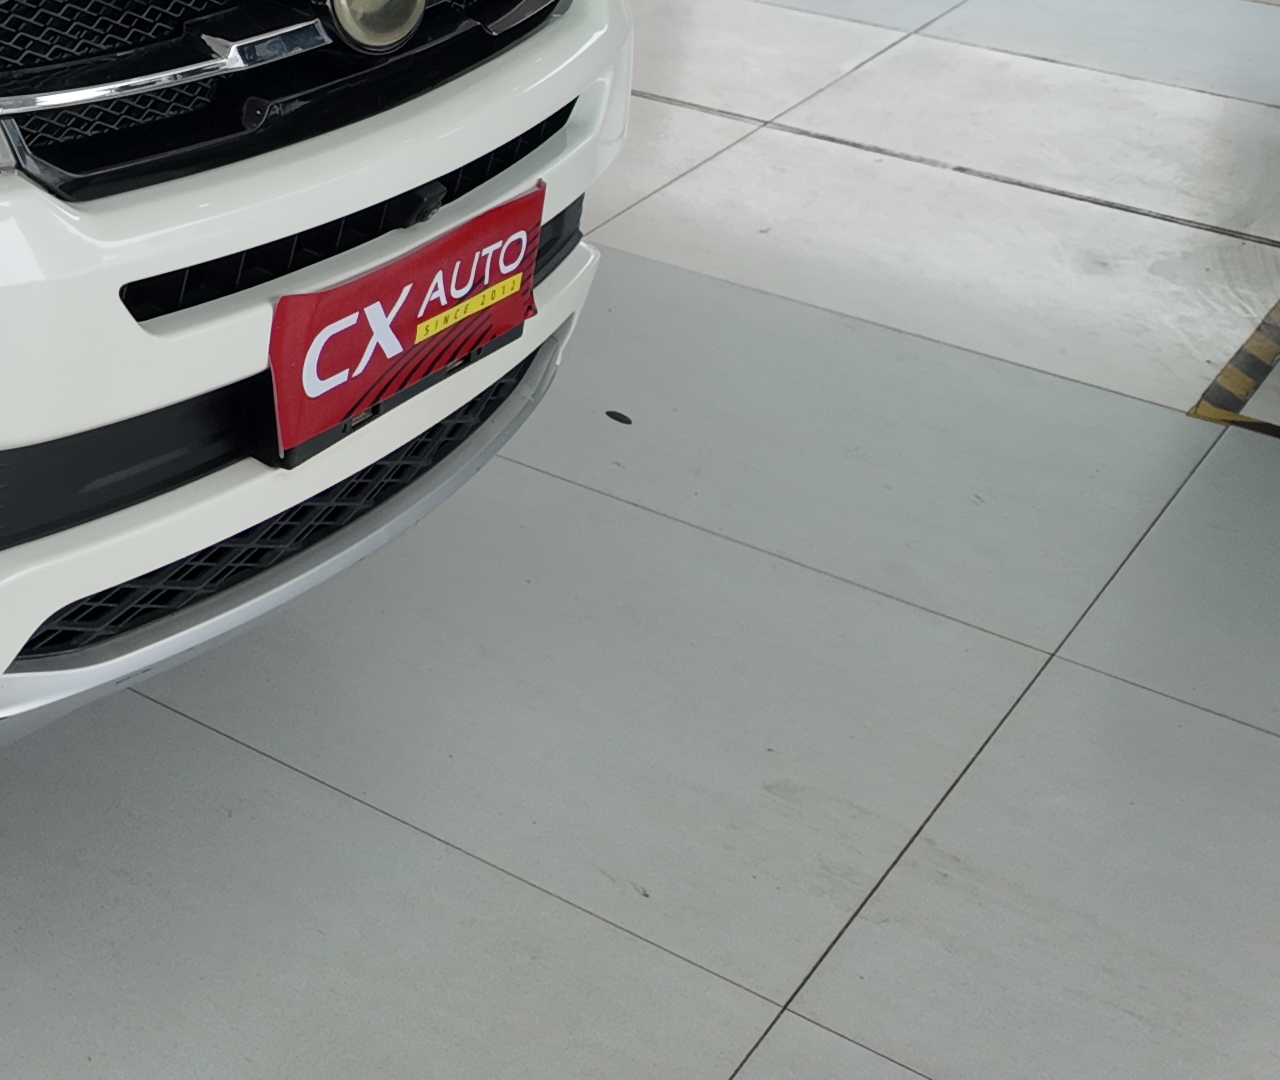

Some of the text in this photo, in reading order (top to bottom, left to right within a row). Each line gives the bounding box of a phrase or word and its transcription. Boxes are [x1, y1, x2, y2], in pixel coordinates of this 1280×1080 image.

[302, 229, 528, 399] CX AUTO
[422, 279, 518, 337] SINCE 2012
